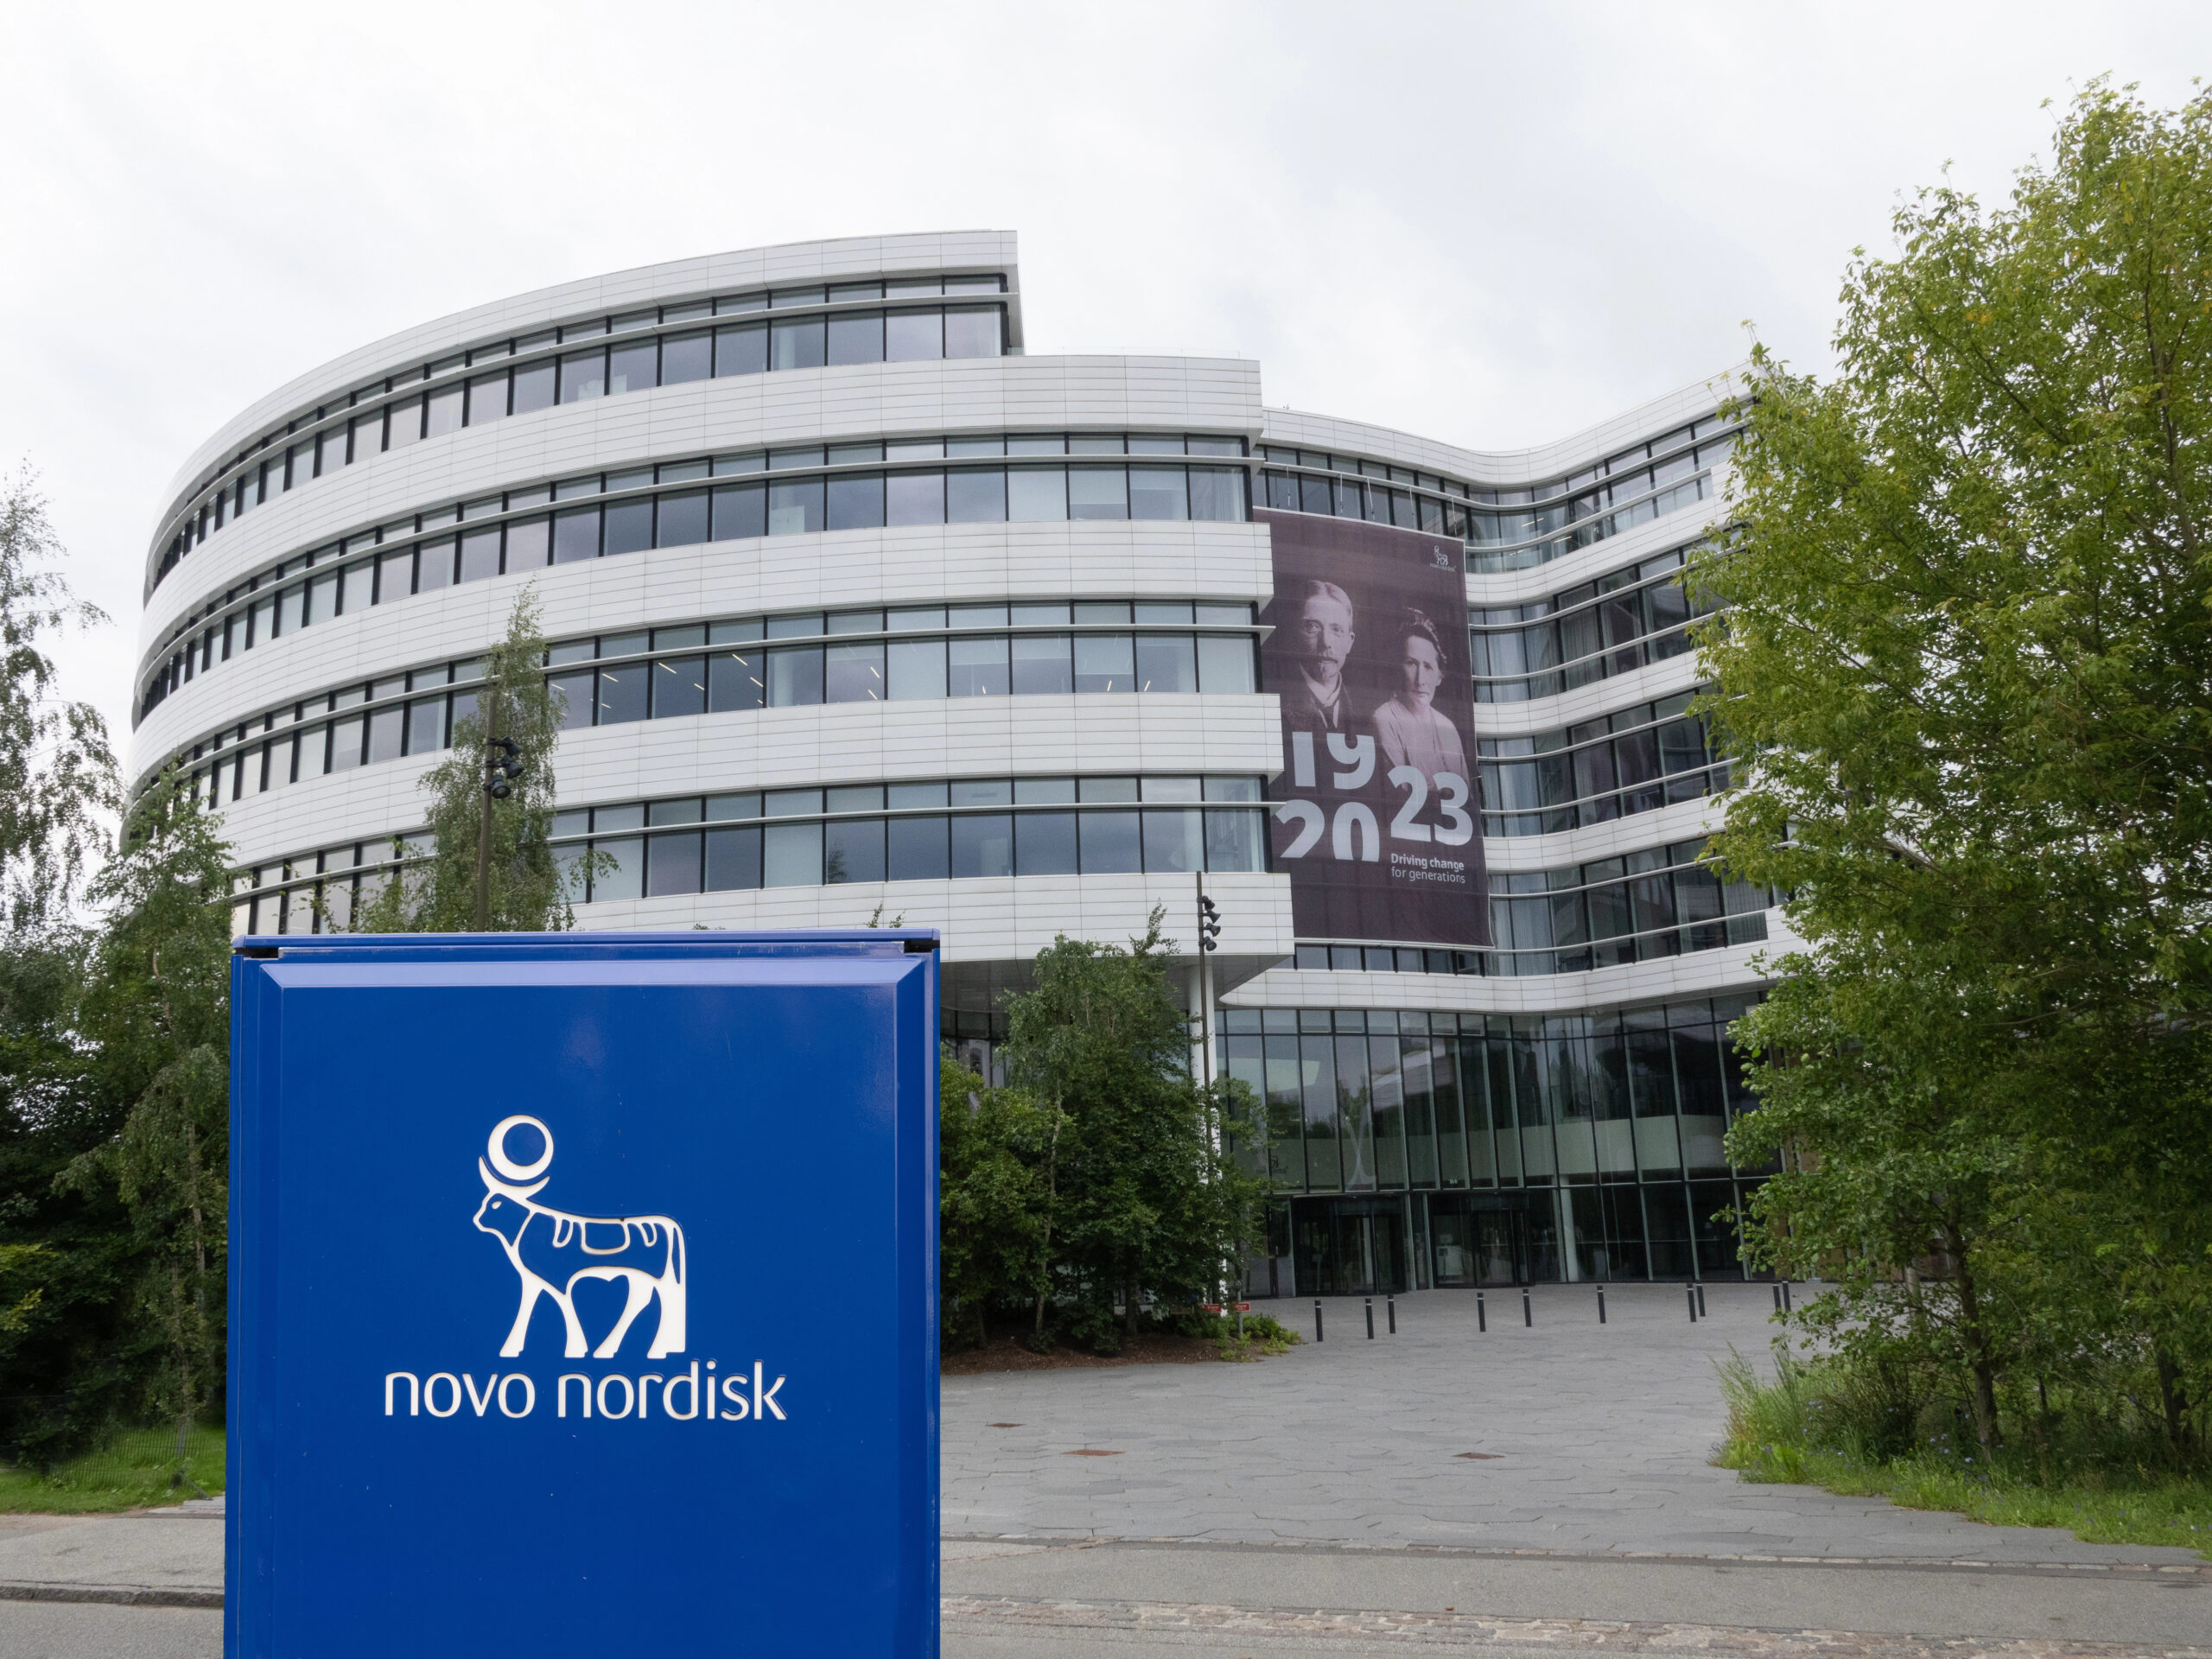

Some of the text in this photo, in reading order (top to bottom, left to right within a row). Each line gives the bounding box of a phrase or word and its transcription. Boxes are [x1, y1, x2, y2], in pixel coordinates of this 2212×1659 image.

[1292, 731, 1376, 790] 19
[1274, 798, 1381, 862] 20
[1387, 765, 1473, 847] 23
[1390, 853, 1465, 873] Driving change
[1391, 866, 1465, 884] for generations
[385, 1360, 787, 1421] novo nordisk
